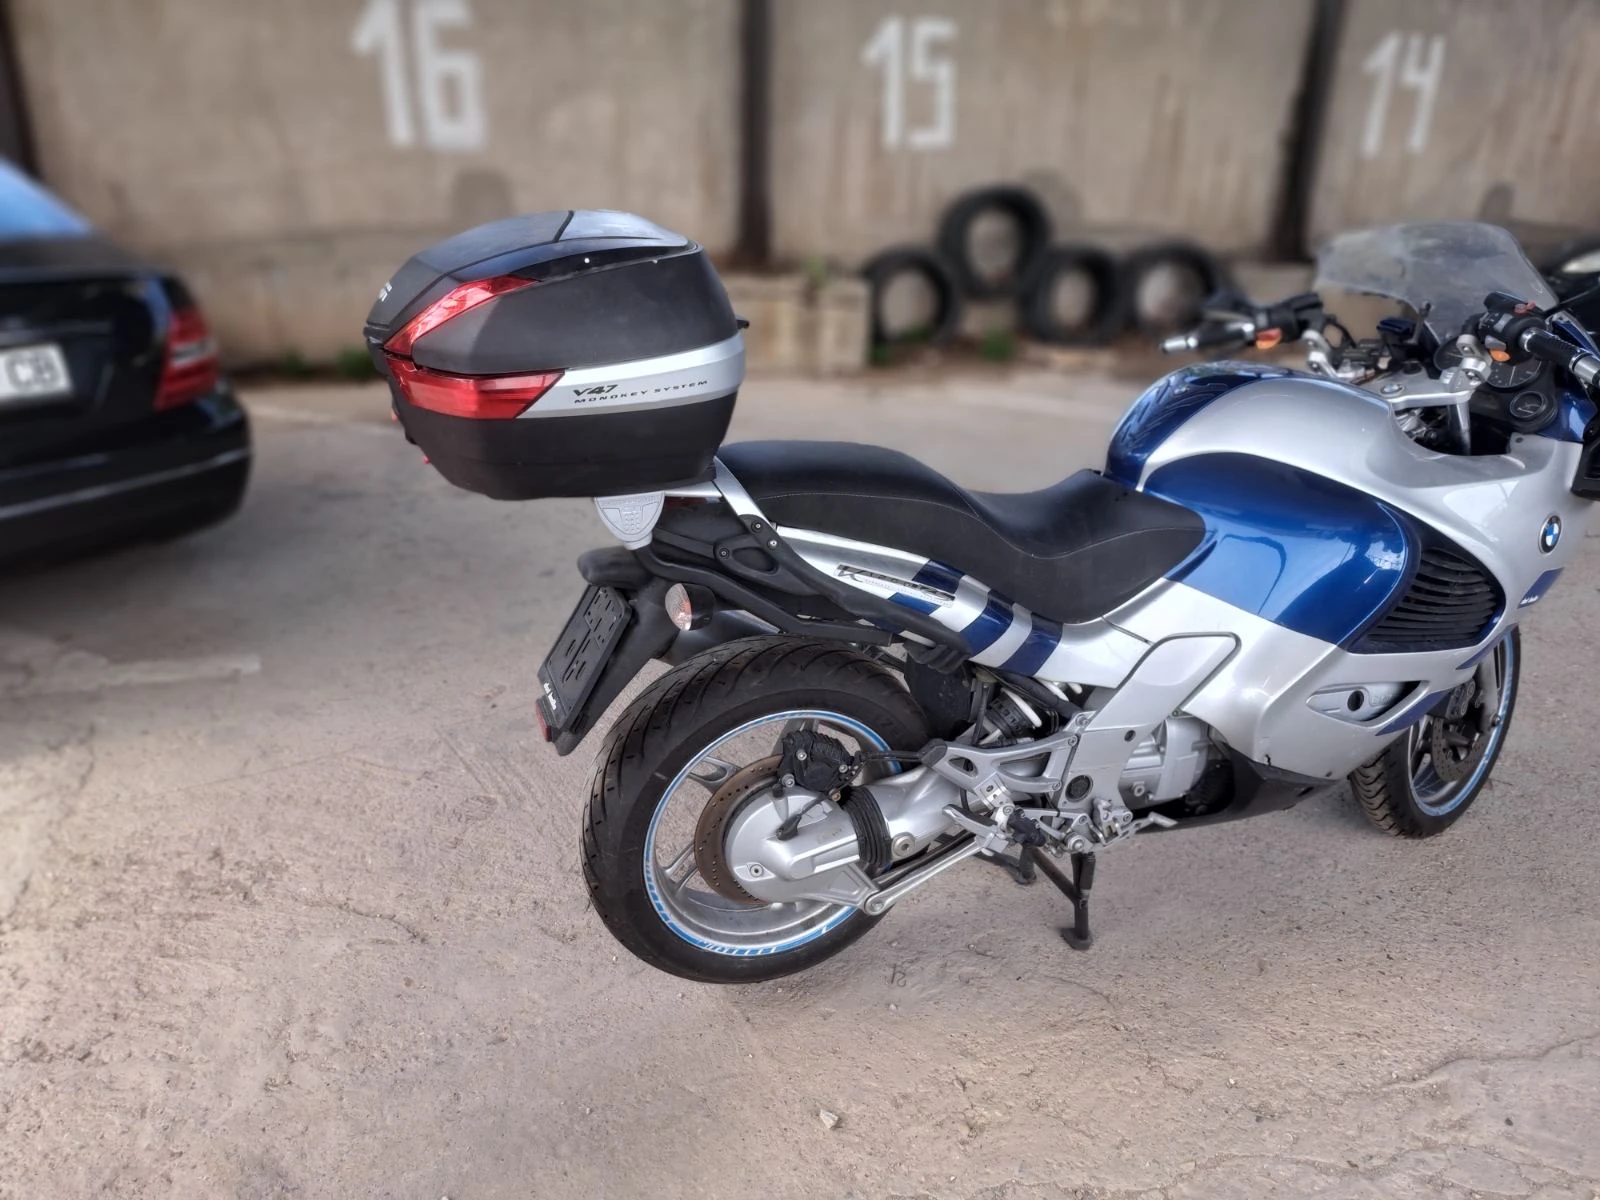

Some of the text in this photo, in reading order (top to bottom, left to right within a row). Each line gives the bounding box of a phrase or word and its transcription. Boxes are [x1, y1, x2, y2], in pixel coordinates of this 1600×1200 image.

[352, 0, 486, 150] 16
[862, 17, 955, 149] 15
[1364, 31, 1446, 156] 14
[573, 384, 618, 396] V47
[574, 380, 707, 403] MONOKEY SYSTEM
